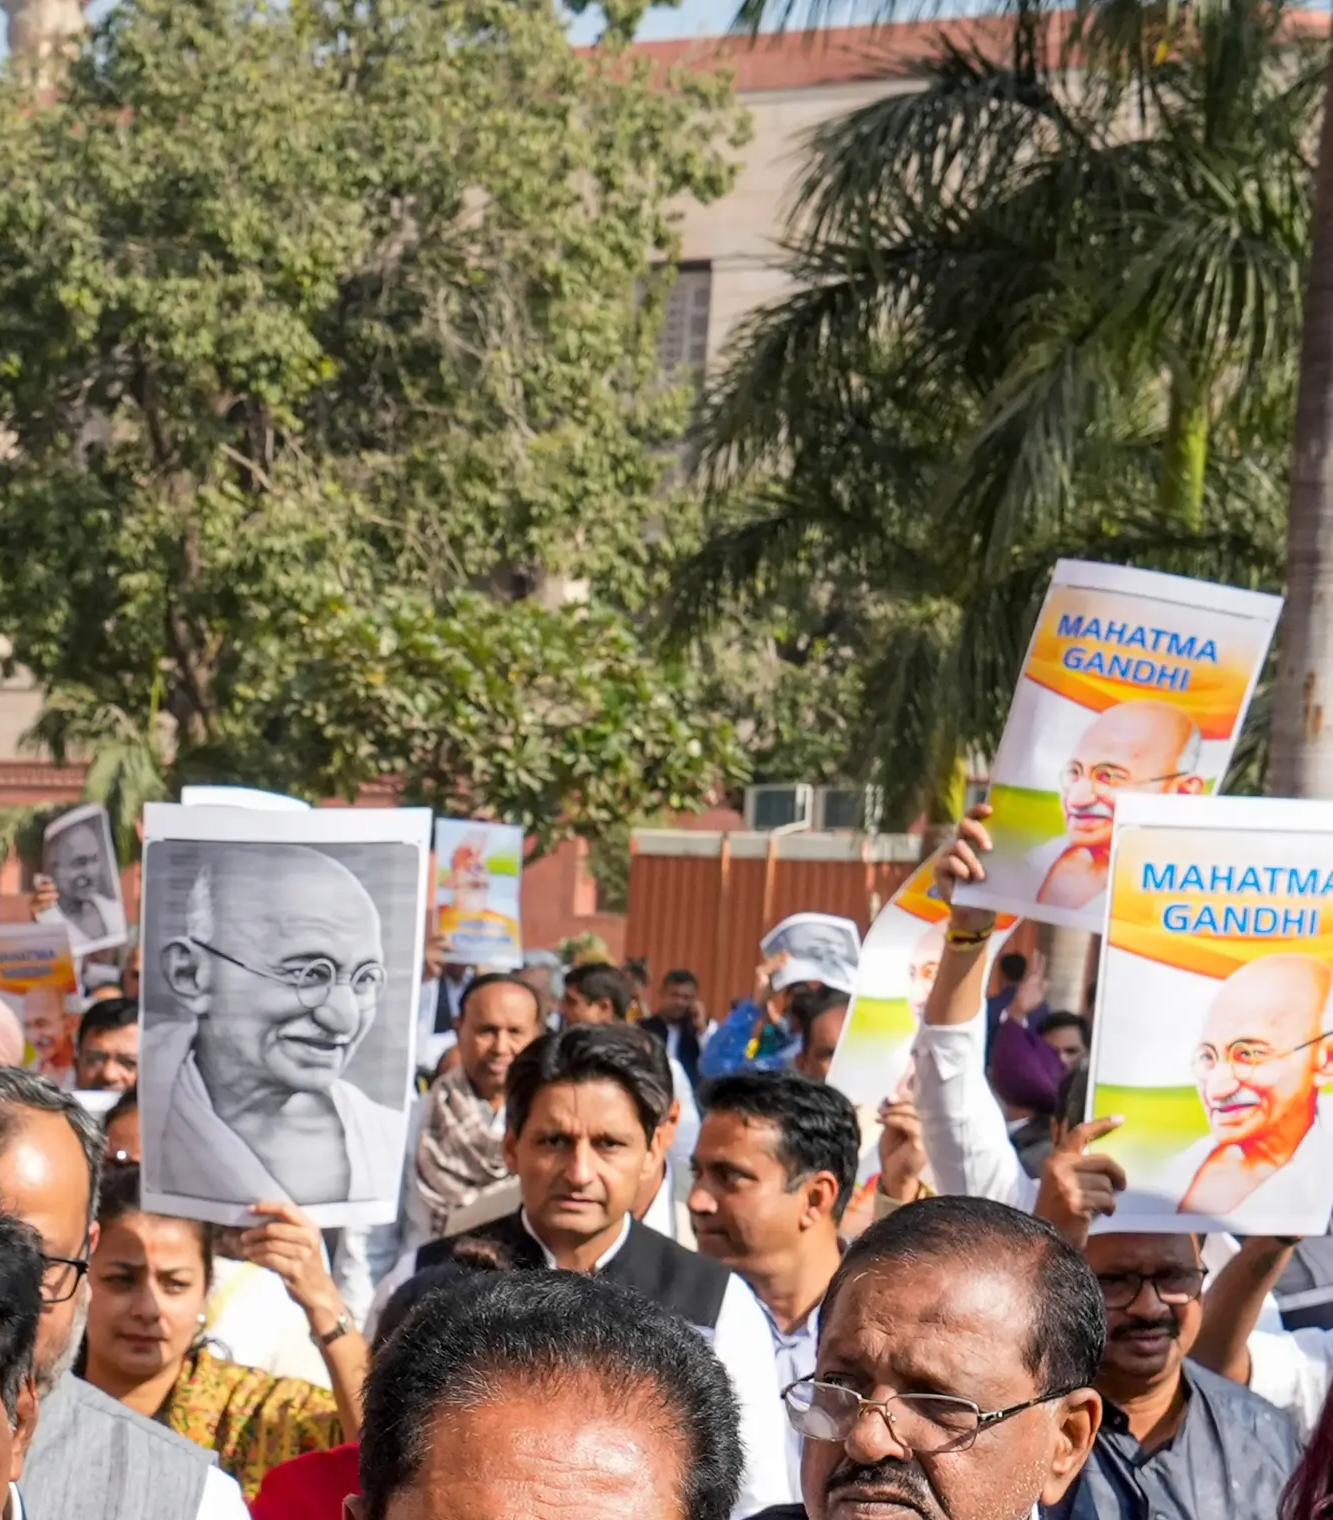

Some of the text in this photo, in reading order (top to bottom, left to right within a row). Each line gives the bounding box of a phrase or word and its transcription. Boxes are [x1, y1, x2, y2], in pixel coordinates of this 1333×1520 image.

[1057, 613, 1218, 663] MAHATMA
[1062, 645, 1191, 692] GANDHI
[1162, 903, 1319, 937] GANDHI
